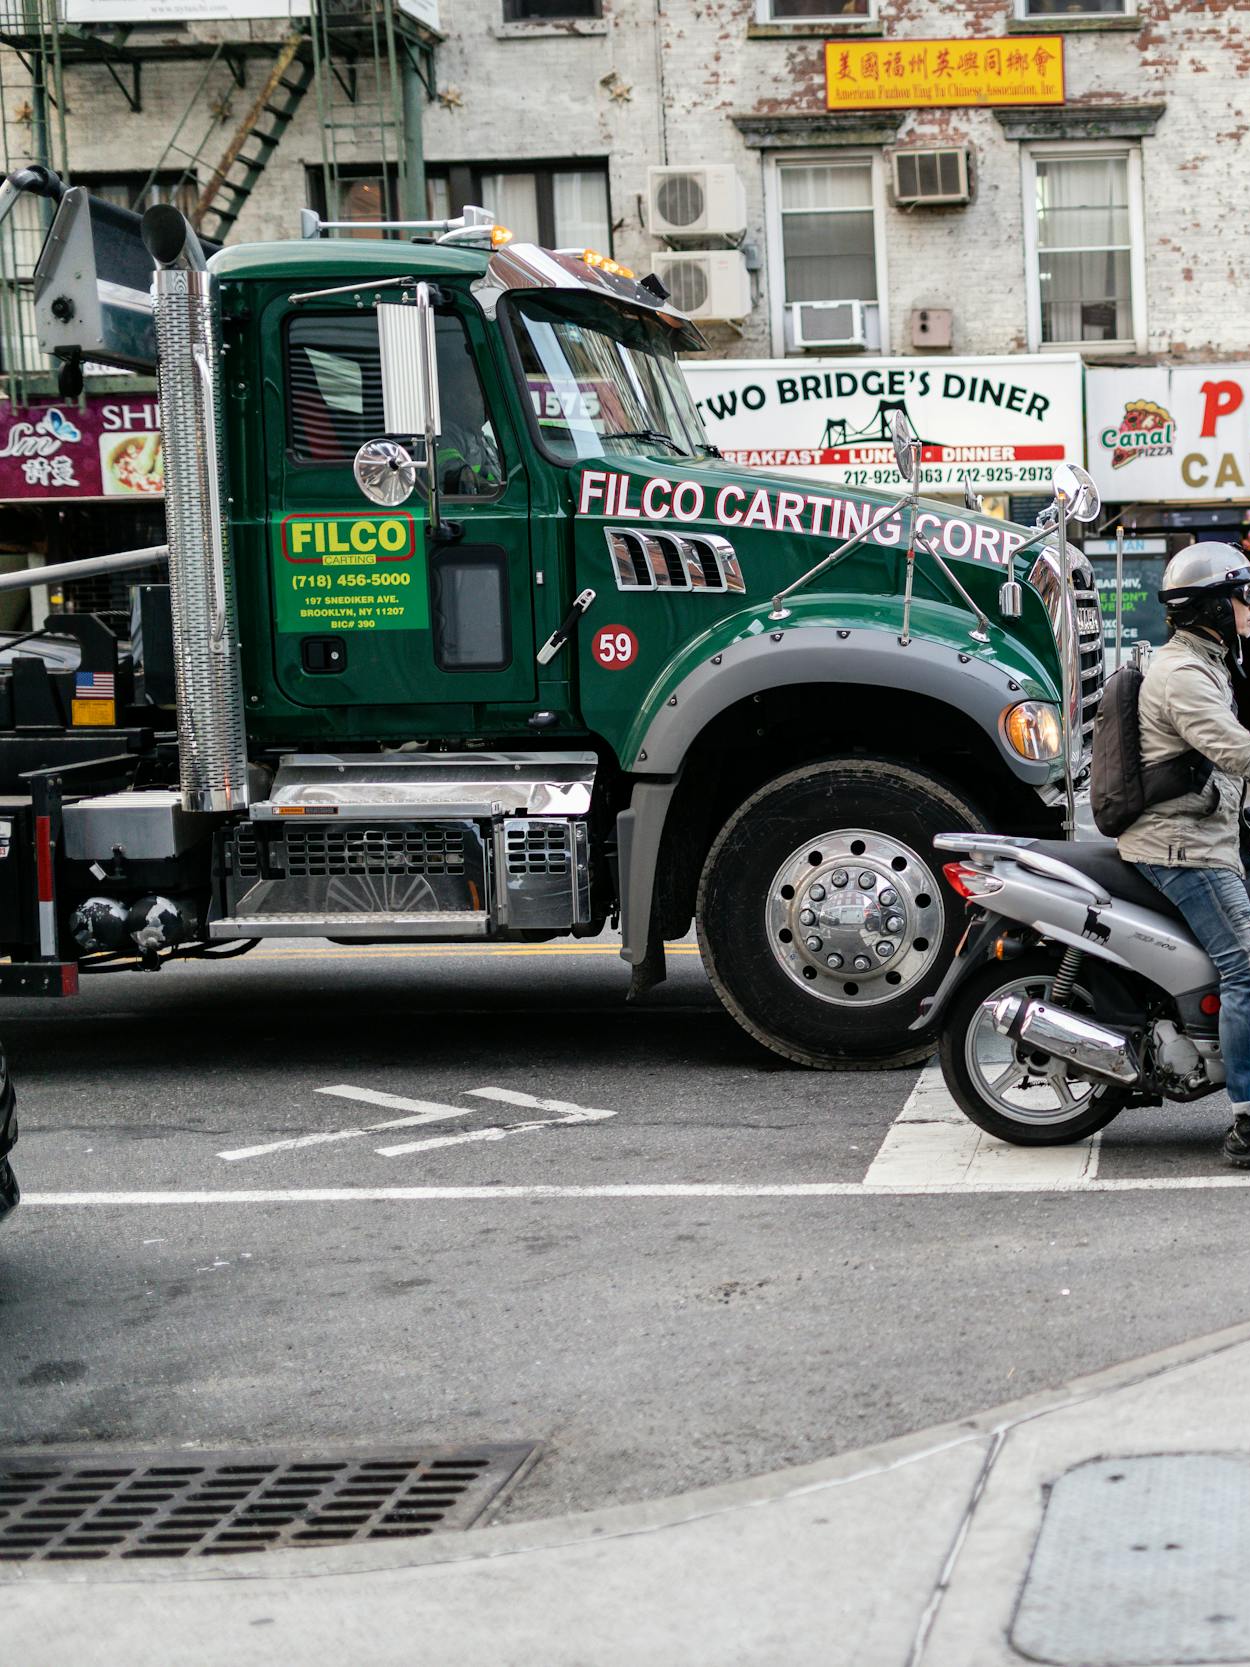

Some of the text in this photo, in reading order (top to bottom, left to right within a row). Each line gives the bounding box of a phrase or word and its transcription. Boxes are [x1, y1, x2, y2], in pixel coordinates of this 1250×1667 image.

[836, 86, 876, 101] American
[948, 82, 983, 98] Chinese
[696, 370, 1052, 427] TWO BRIDGE'S DINER
[1100, 425, 1175, 450] Canal
[724, 446, 1016, 466] REAKFAST LUNC DINNER
[1137, 446, 1174, 459] PIZZA
[955, 465, 1053, 484] 212-925-2973
[578, 470, 705, 522] FILCO
[714, 485, 902, 547] CARTING
[291, 520, 407, 553] FILCO
[1104, 540, 1145, 552] TAN
[324, 554, 376, 565] CARTING
[292, 572, 411, 590] (718) 456-5000
[1096, 578, 1117, 589] EAR
[305, 595, 400, 605] 197 SNEDIKER AVE.
[300, 607, 405, 618] BROOKLYN, NY 11207
[331, 620, 376, 629] BIC# 390
[1103, 627, 1139, 639] IECE
[599, 633, 633, 663] 59
